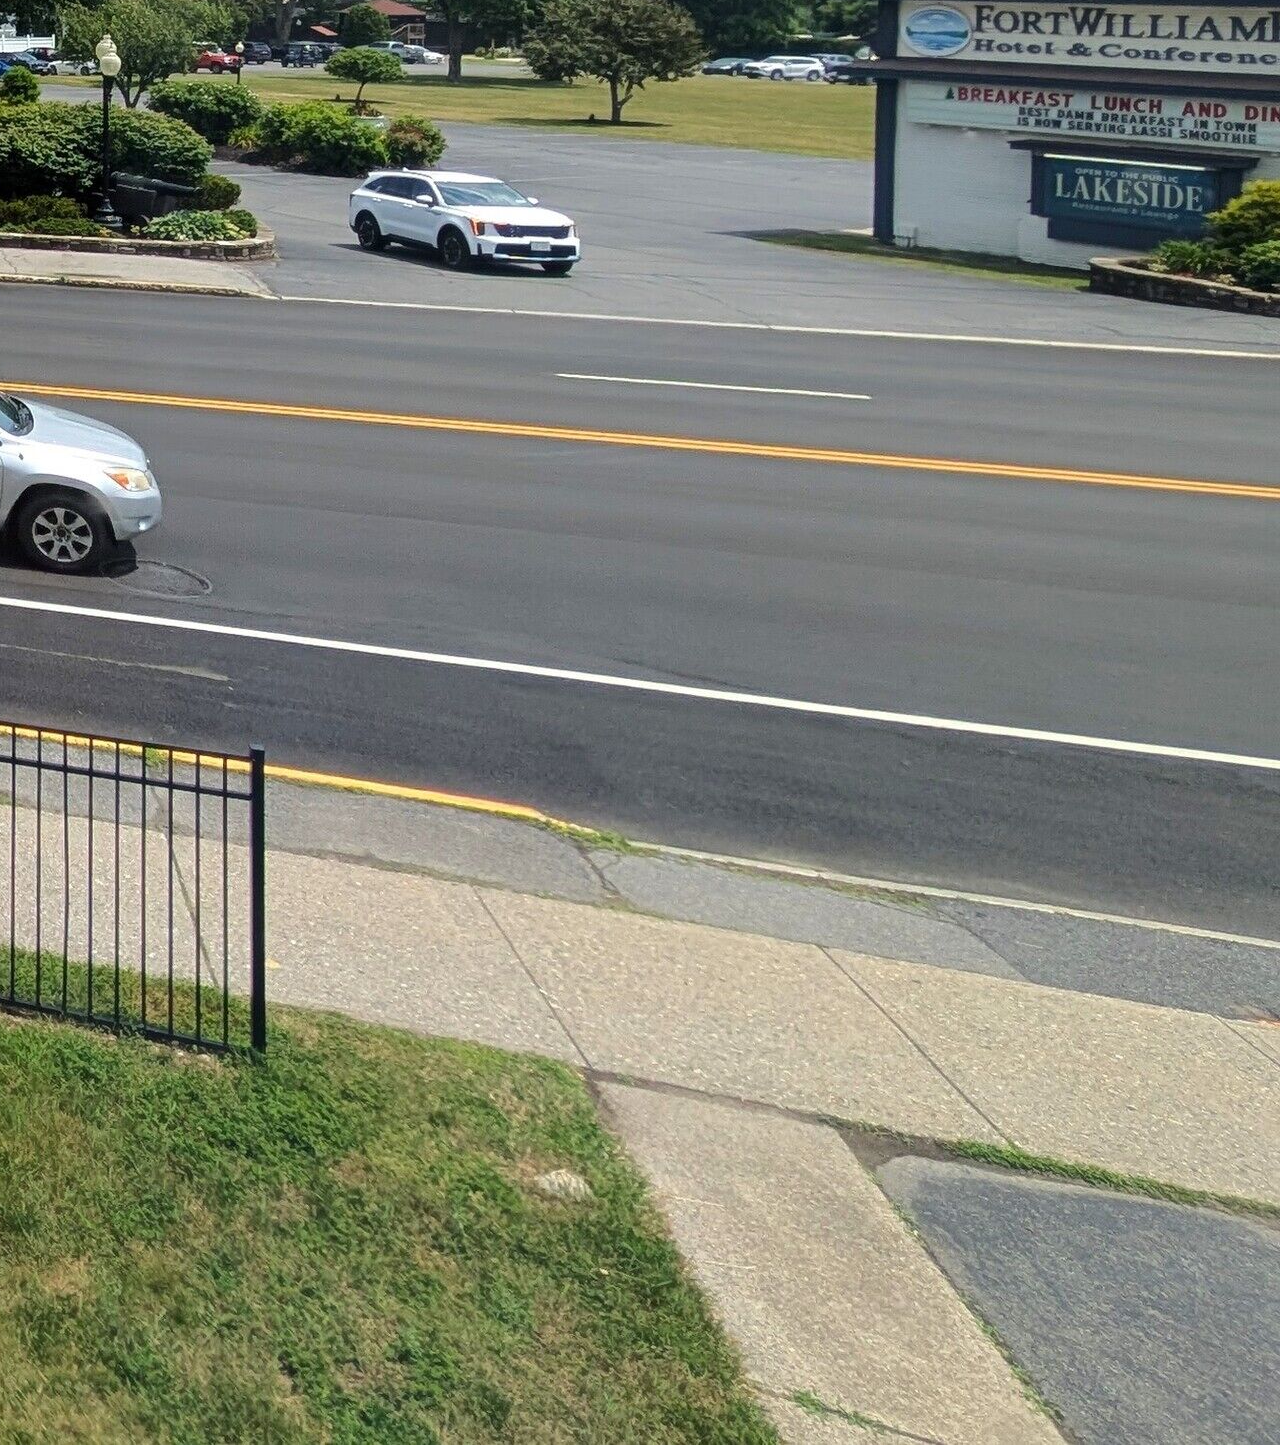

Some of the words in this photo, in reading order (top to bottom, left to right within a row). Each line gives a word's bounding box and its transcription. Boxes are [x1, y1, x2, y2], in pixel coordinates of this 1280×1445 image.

[973, 38, 1055, 54] Hotel
[1067, 42, 1092, 56] &
[1098, 43, 1280, 65] Conferenc
[958, 87, 1074, 107] BREAKFAST
[1091, 95, 1162, 114] LUNCH
[1182, 101, 1227, 118] AND
[1017, 116, 1030, 126] IS
[1034, 117, 1062, 128] NOW
[1068, 120, 1126, 134] SERVING
[1180, 128, 1257, 145] SMOOTHIE
[1019, 106, 1050, 117] BEST
[1102, 112, 1184, 128] BREAKFAST
[1194, 119, 1208, 130] IN
[1214, 120, 1257, 133] TOWN
[1075, 167, 1102, 176] OPEN
[1105, 169, 1118, 178] TO
[1121, 171, 1139, 180] THE
[1142, 173, 1179, 184] PUBLIC
[1055, 173, 1203, 212] LAKESIDE
